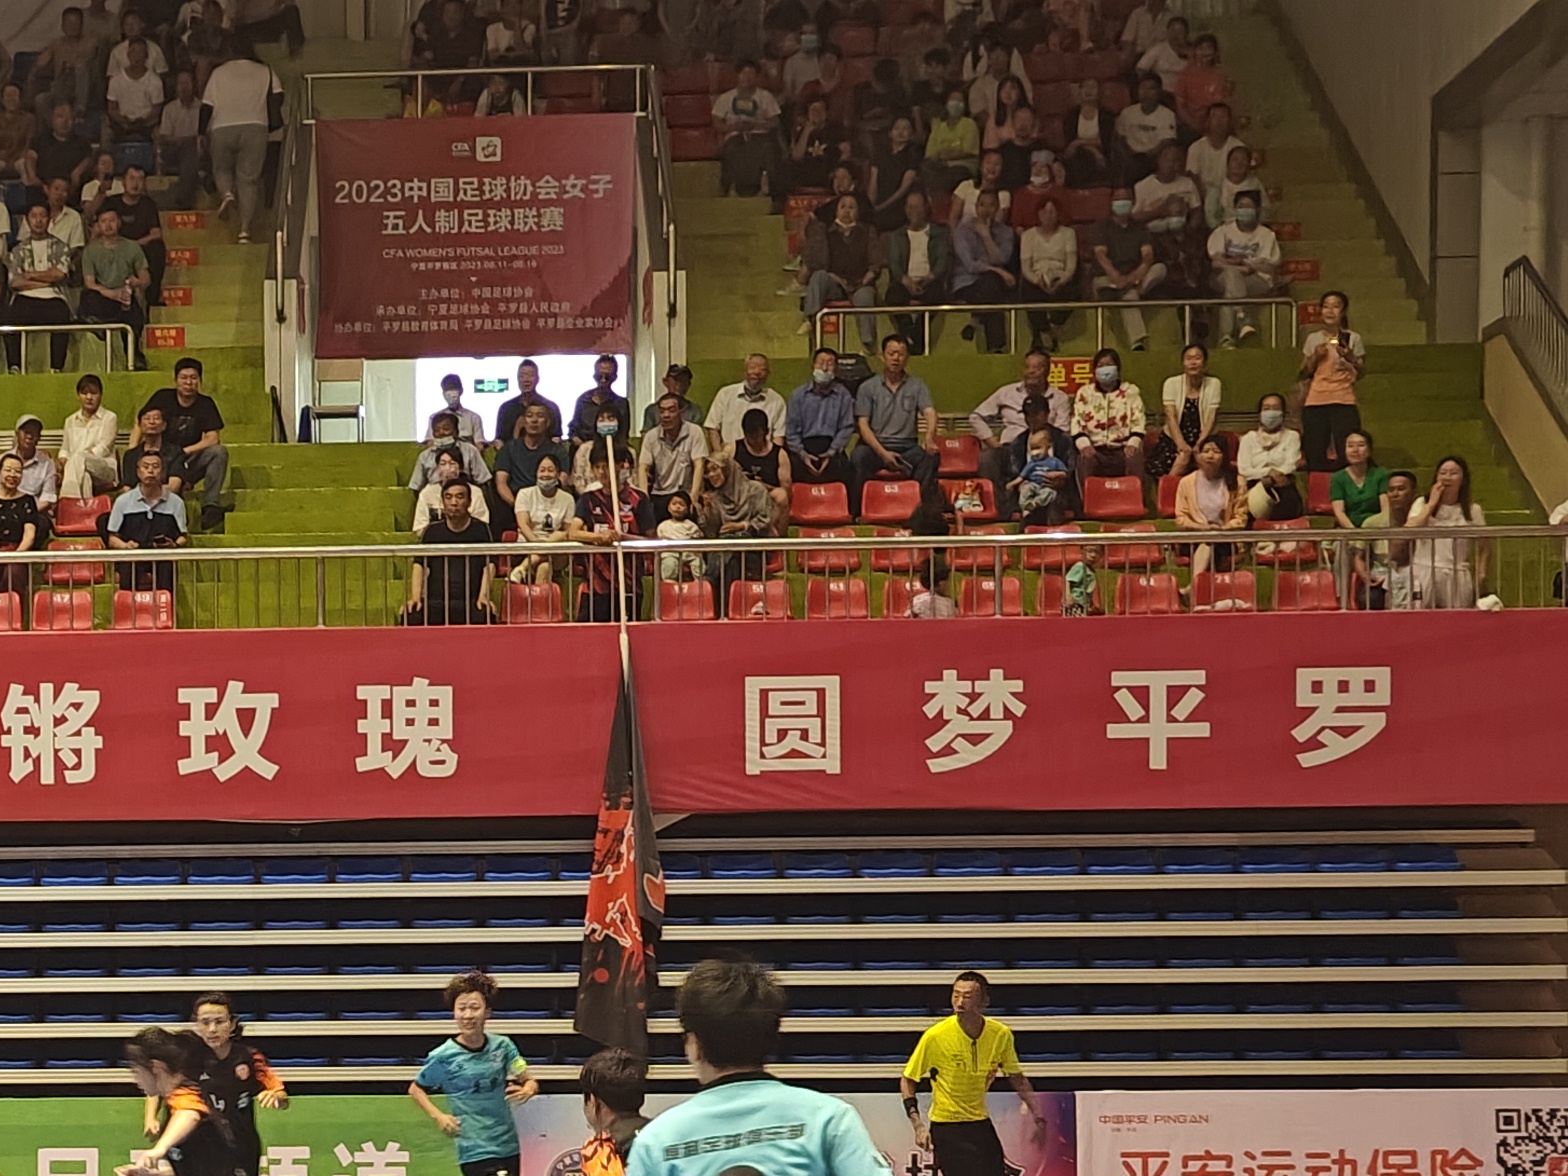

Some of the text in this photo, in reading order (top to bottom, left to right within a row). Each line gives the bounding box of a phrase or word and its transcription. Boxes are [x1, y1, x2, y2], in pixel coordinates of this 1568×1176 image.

[334, 174, 614, 204] 2023中国足球协会女子
[382, 207, 565, 235] 五人制足球联赛
[743, 666, 1394, 776] 圆梦平罗
